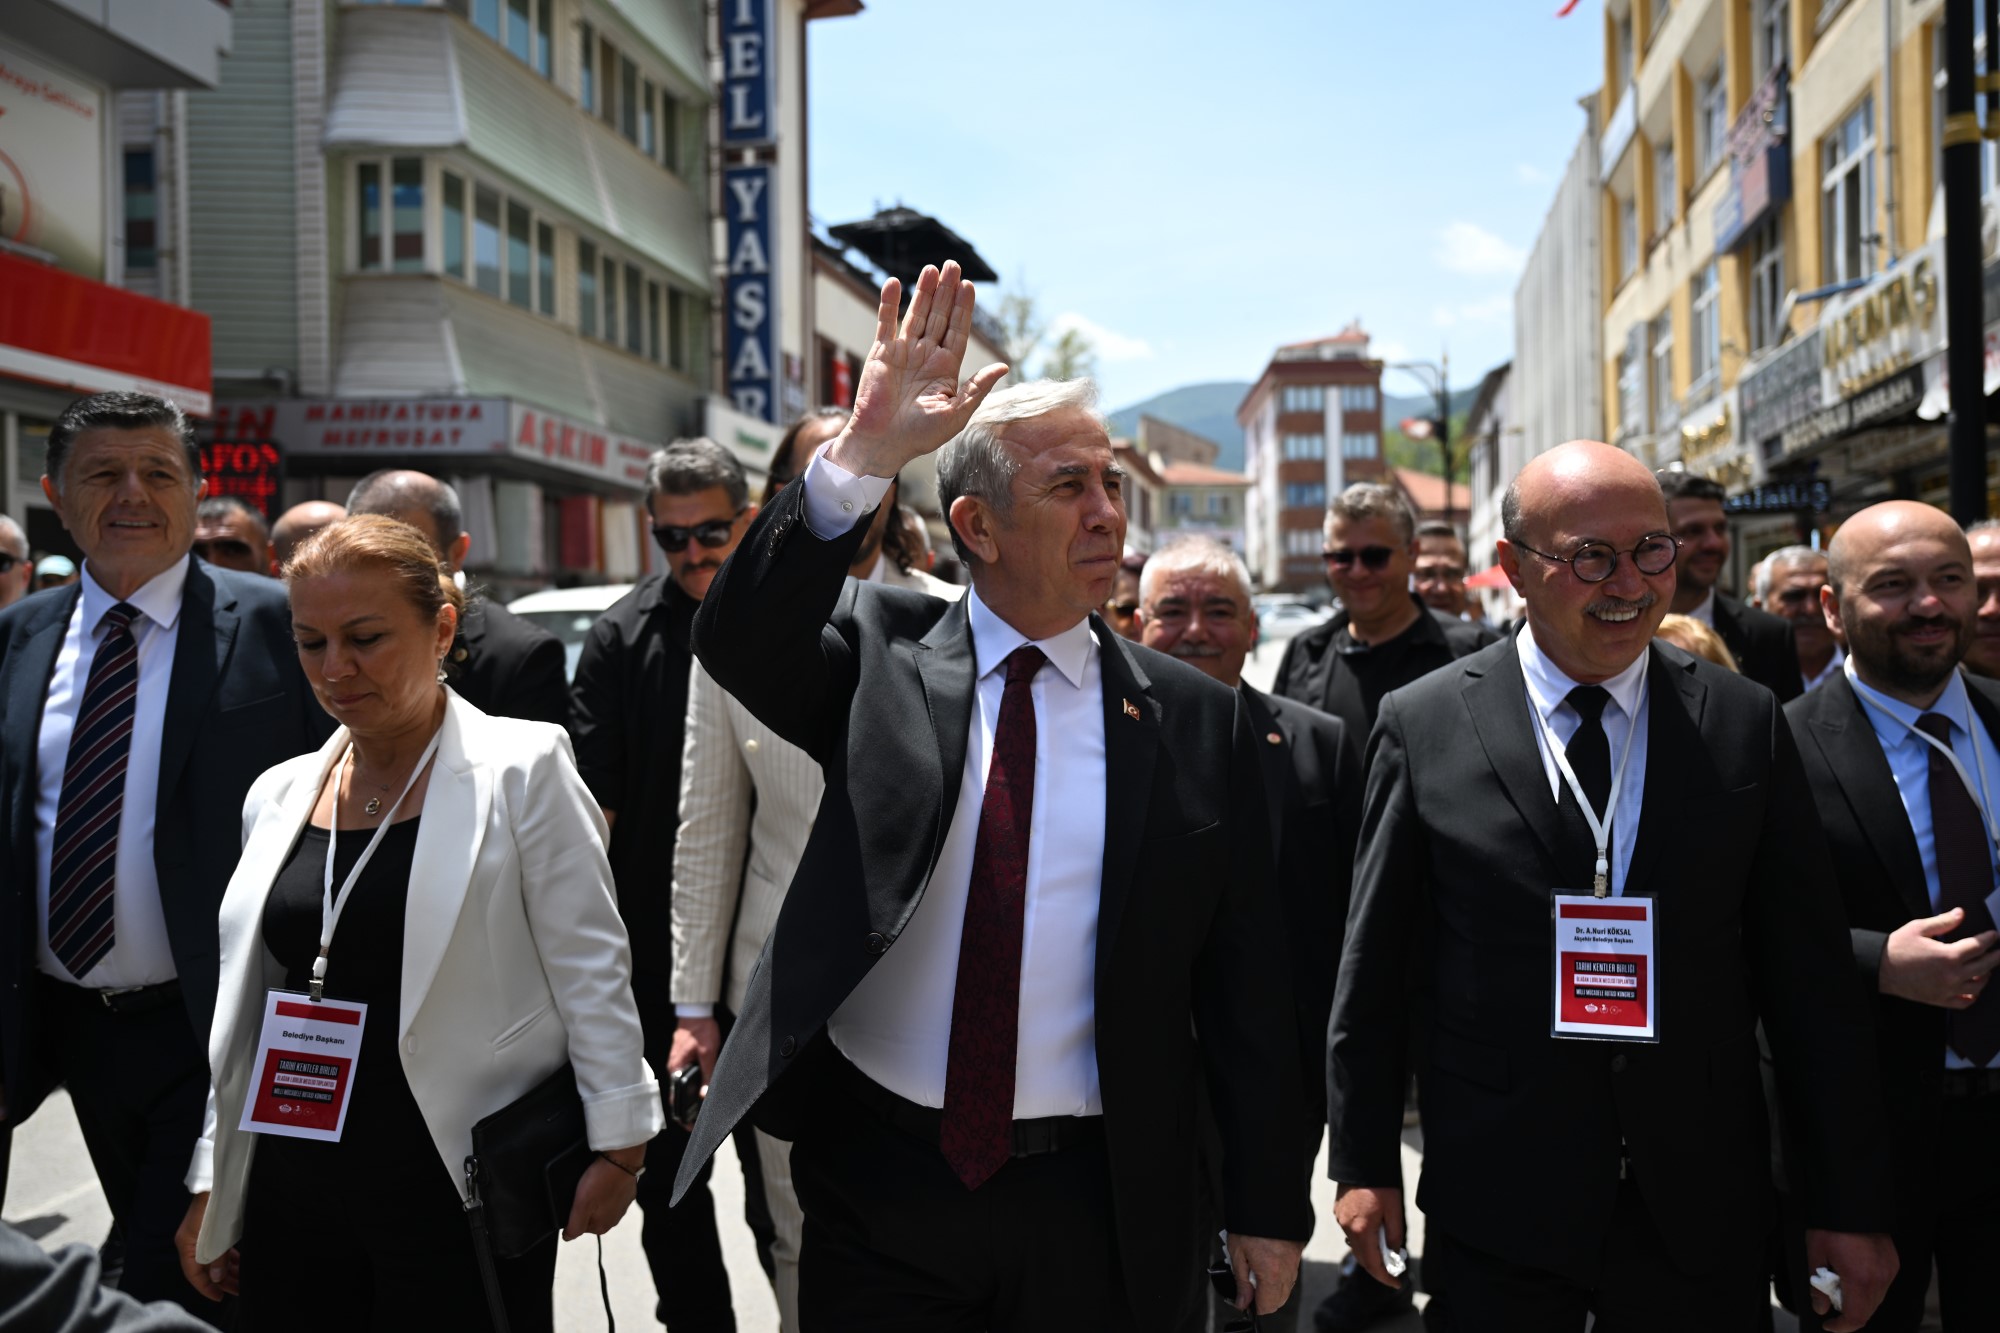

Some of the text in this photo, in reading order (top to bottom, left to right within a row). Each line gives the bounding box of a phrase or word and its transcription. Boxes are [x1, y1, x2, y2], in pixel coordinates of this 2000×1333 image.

[1607, 927, 1632, 936] KÖKSAL
[1592, 936, 1614, 944] Belediye
[1593, 962, 1616, 973] KENTLER
[282, 1031, 345, 1045] Belediye Başkanı
[296, 1062, 319, 1074] KENTLER
